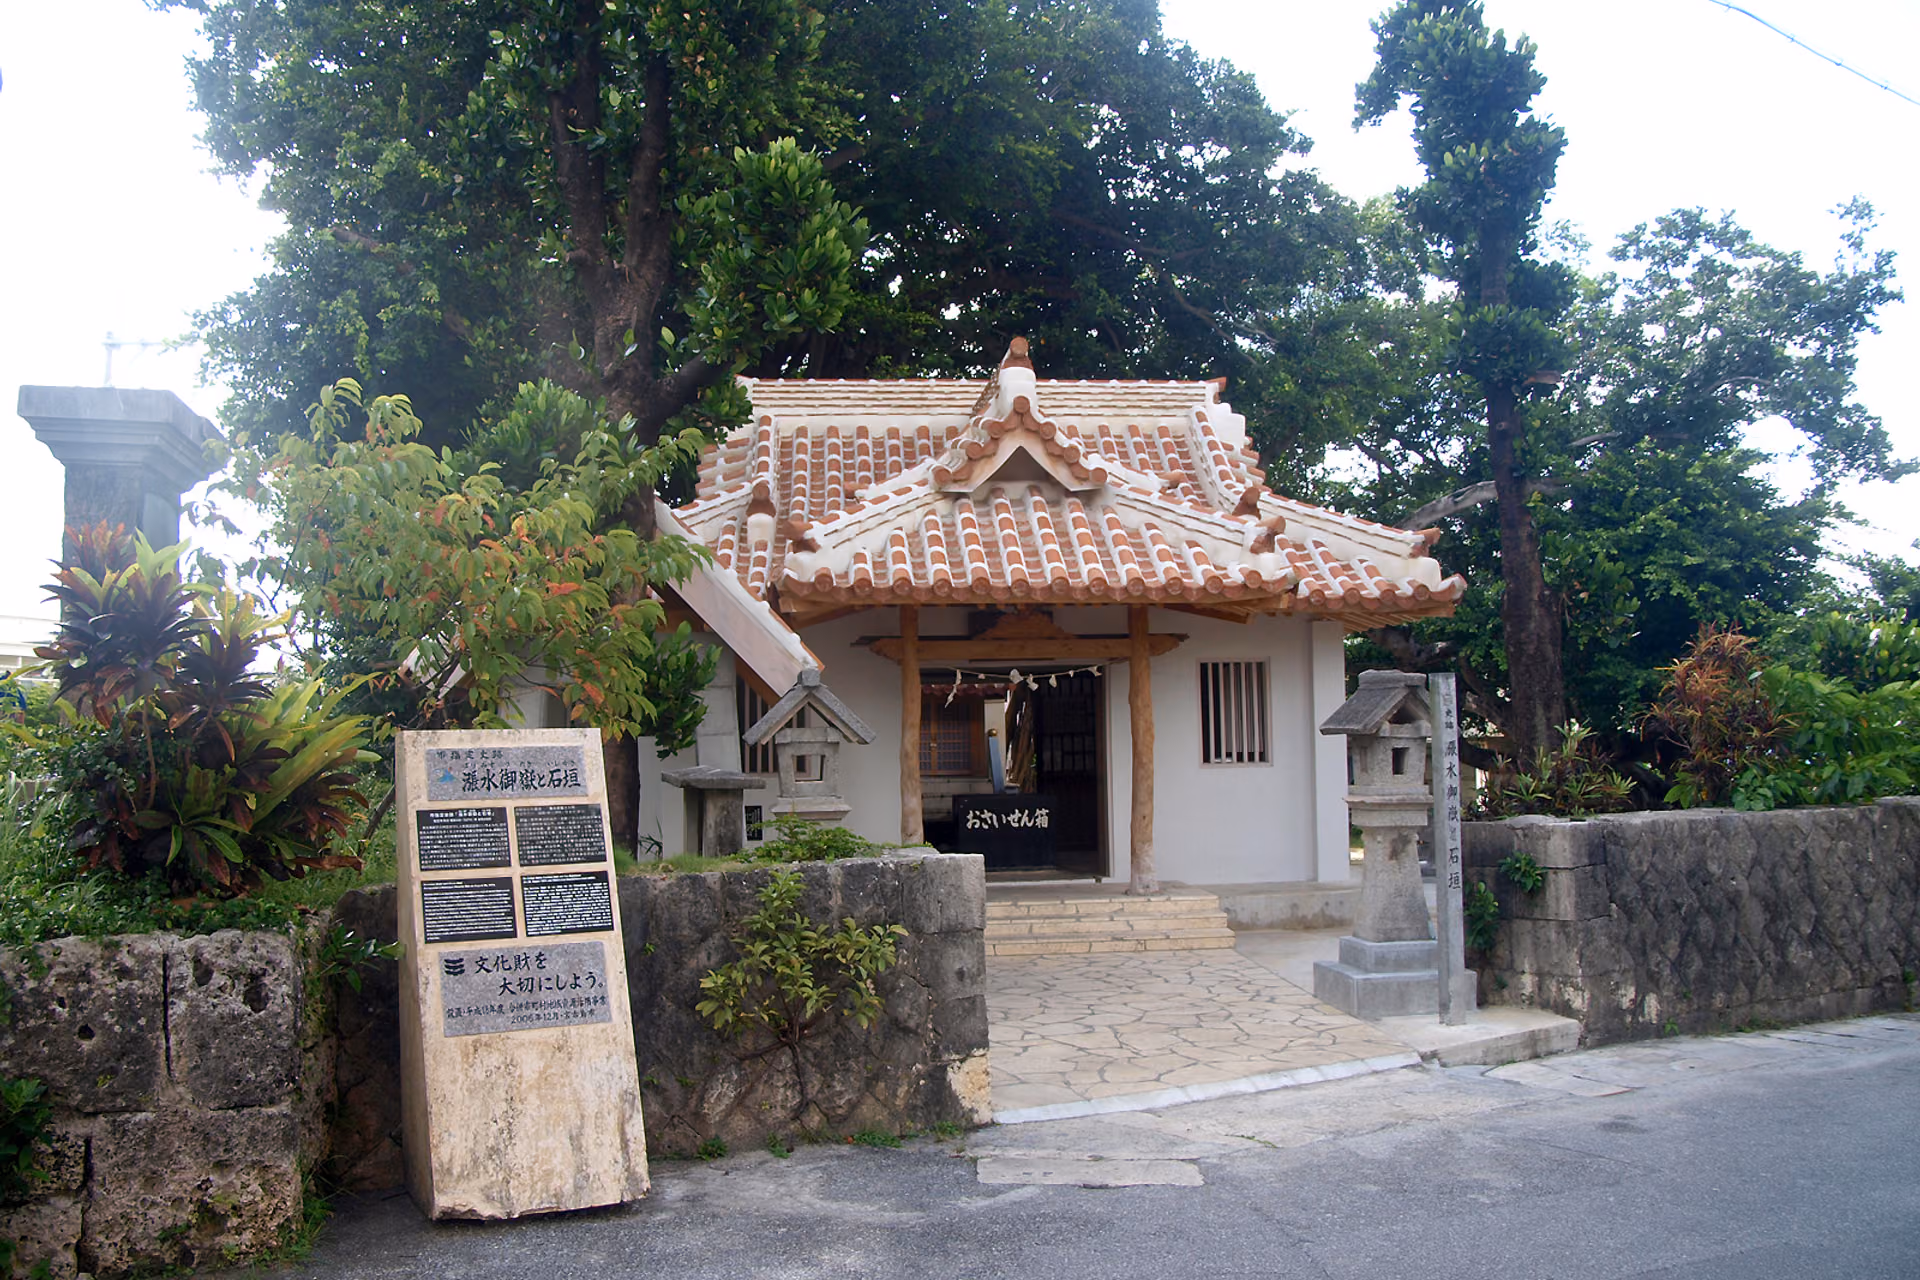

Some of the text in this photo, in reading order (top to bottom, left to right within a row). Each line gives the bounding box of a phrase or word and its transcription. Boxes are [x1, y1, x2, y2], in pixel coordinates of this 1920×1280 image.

[966, 808, 1050, 829] おさいせん箱
[474, 951, 547, 974] 文化財を
[498, 971, 604, 996] 大切にしよう。
